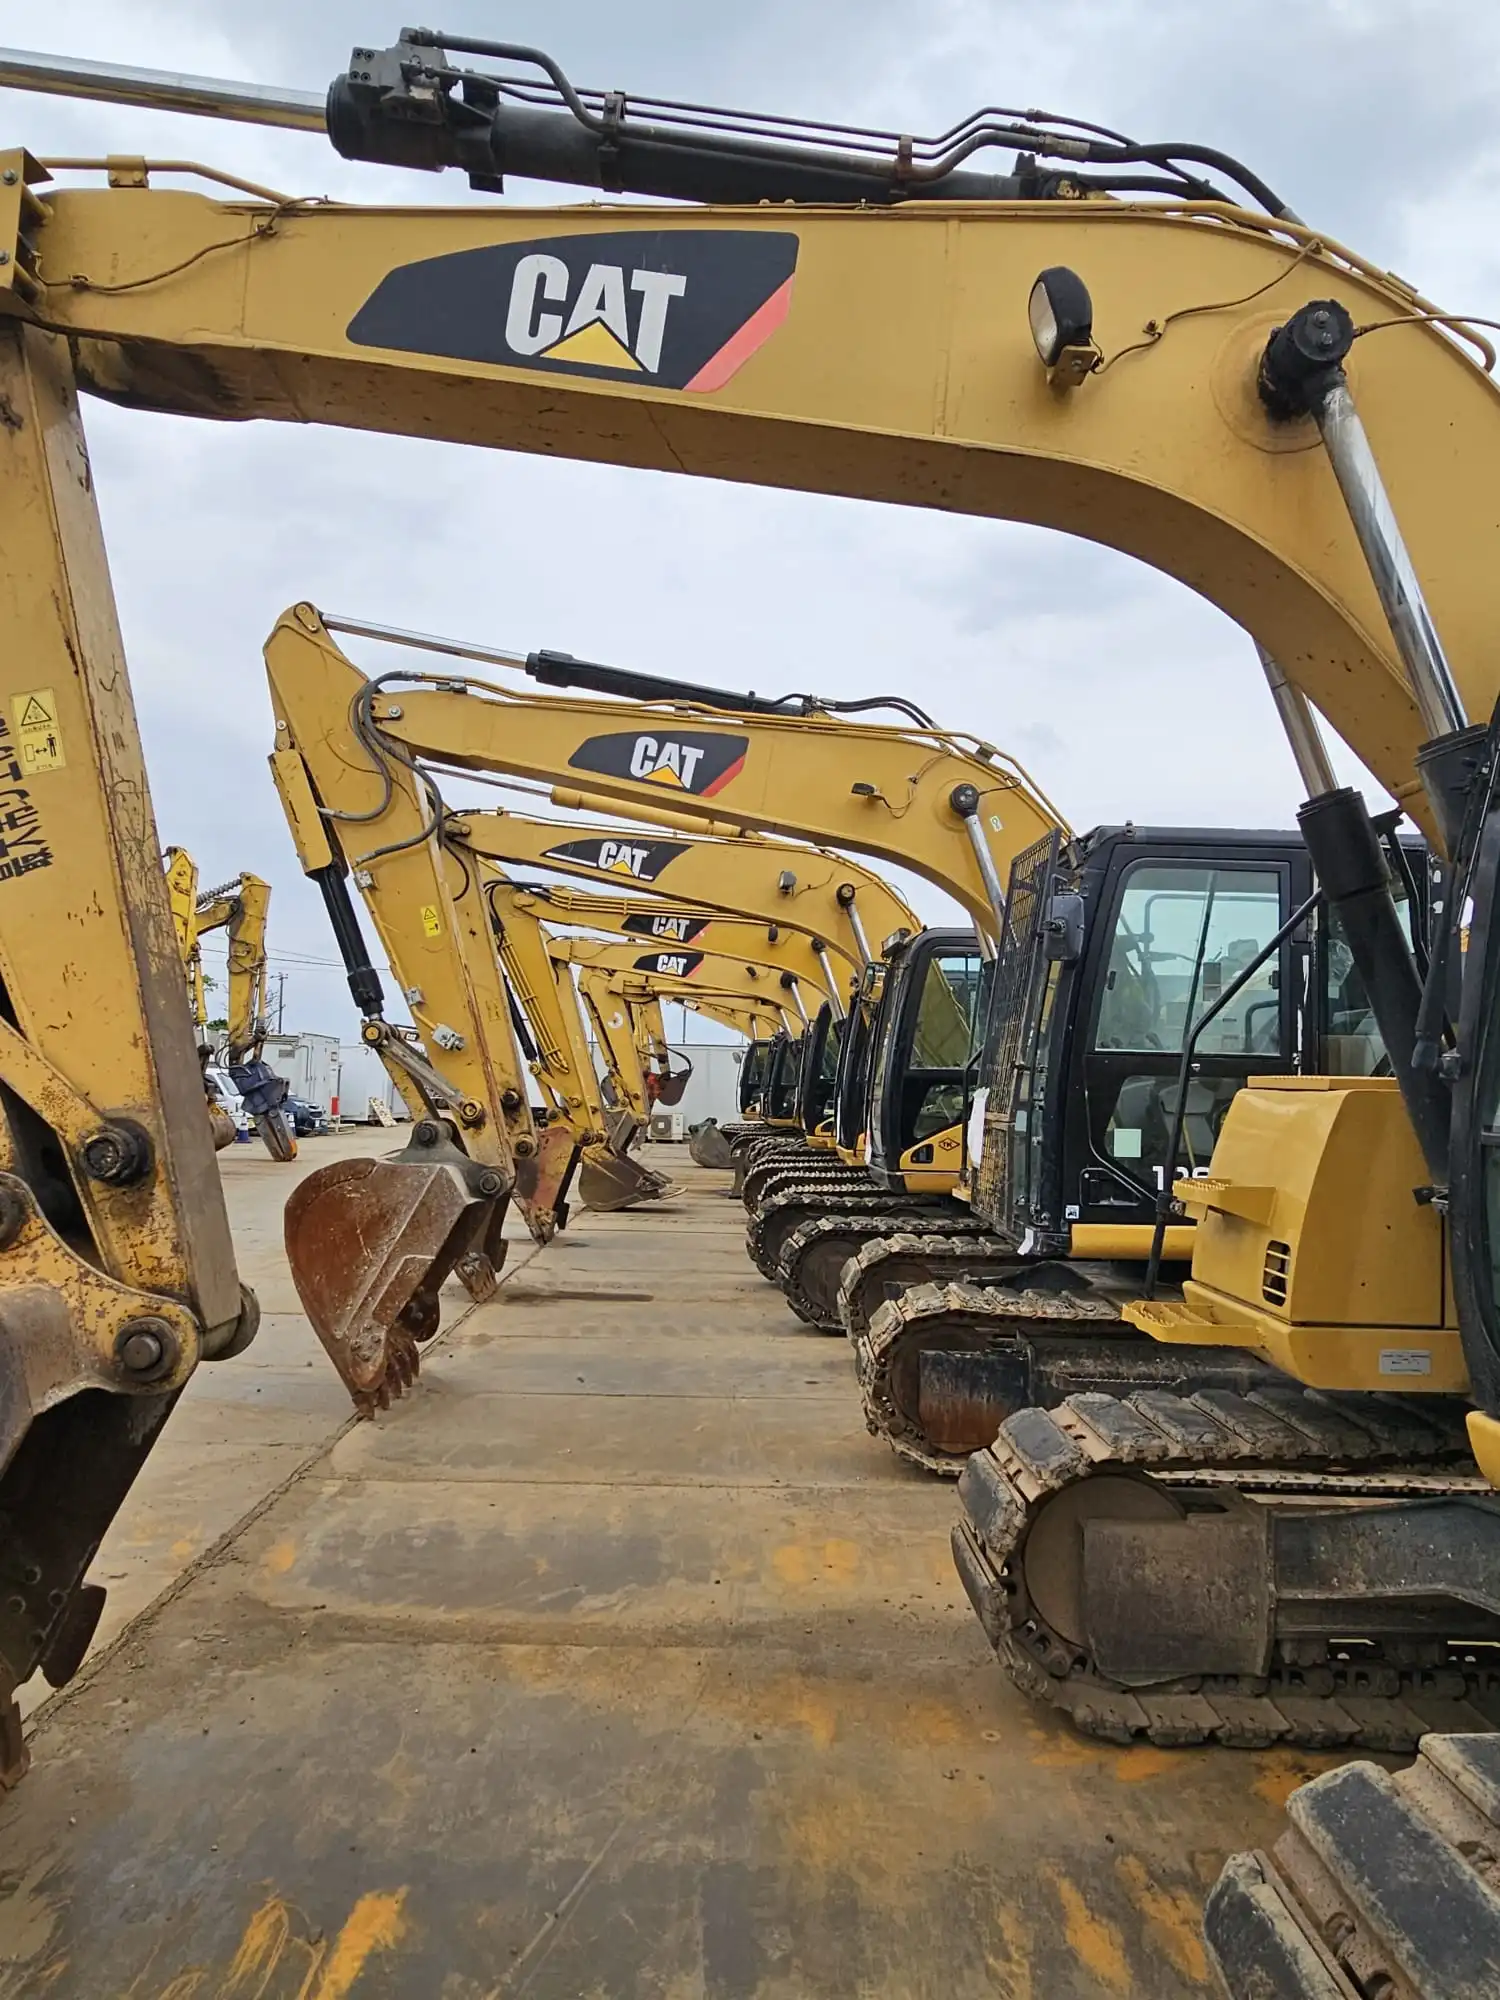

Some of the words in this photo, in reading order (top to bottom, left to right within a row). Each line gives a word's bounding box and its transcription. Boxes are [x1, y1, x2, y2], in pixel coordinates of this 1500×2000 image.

[505, 254, 687, 374] CAT
[629, 736, 705, 789] CAT
[598, 841, 650, 877] CAT
[652, 916, 690, 941] CAT
[656, 954, 688, 976] CAT
